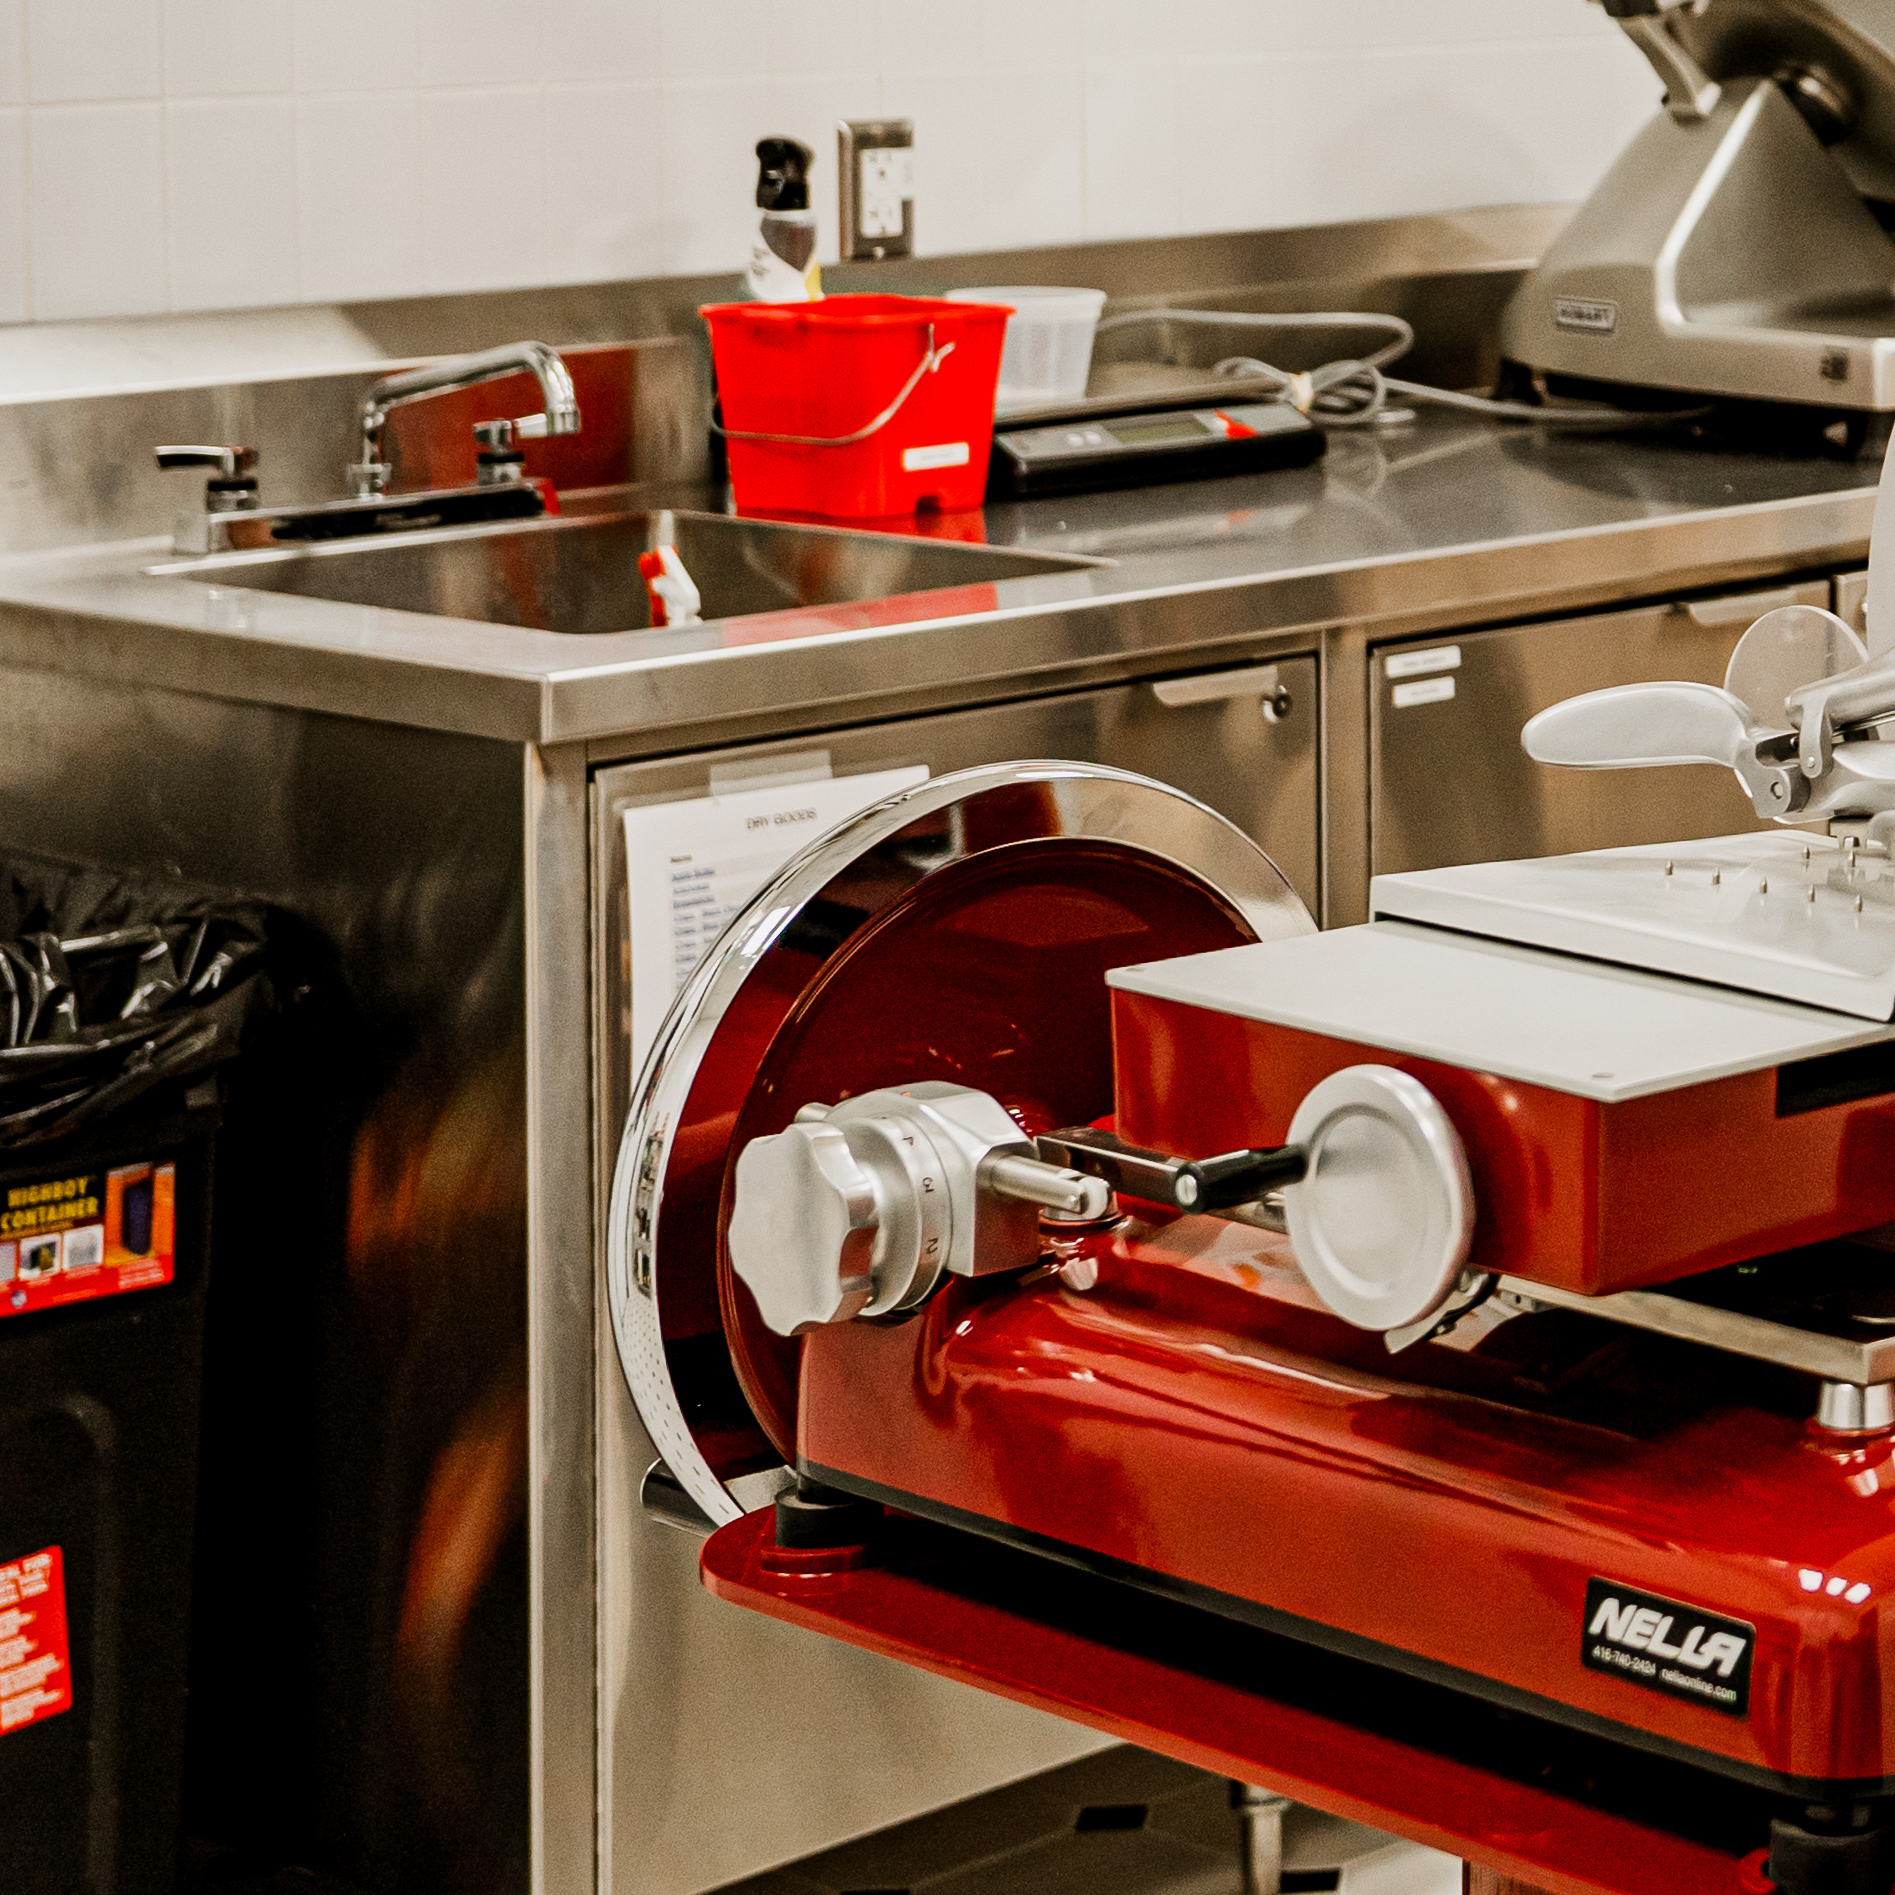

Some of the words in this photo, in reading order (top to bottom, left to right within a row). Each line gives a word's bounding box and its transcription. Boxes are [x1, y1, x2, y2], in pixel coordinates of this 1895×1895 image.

[1588, 1596, 1747, 1677] NELLA
[1591, 1644, 1657, 1676] 416-740-2424
[1659, 1668, 1738, 1704] nellaonline.com
